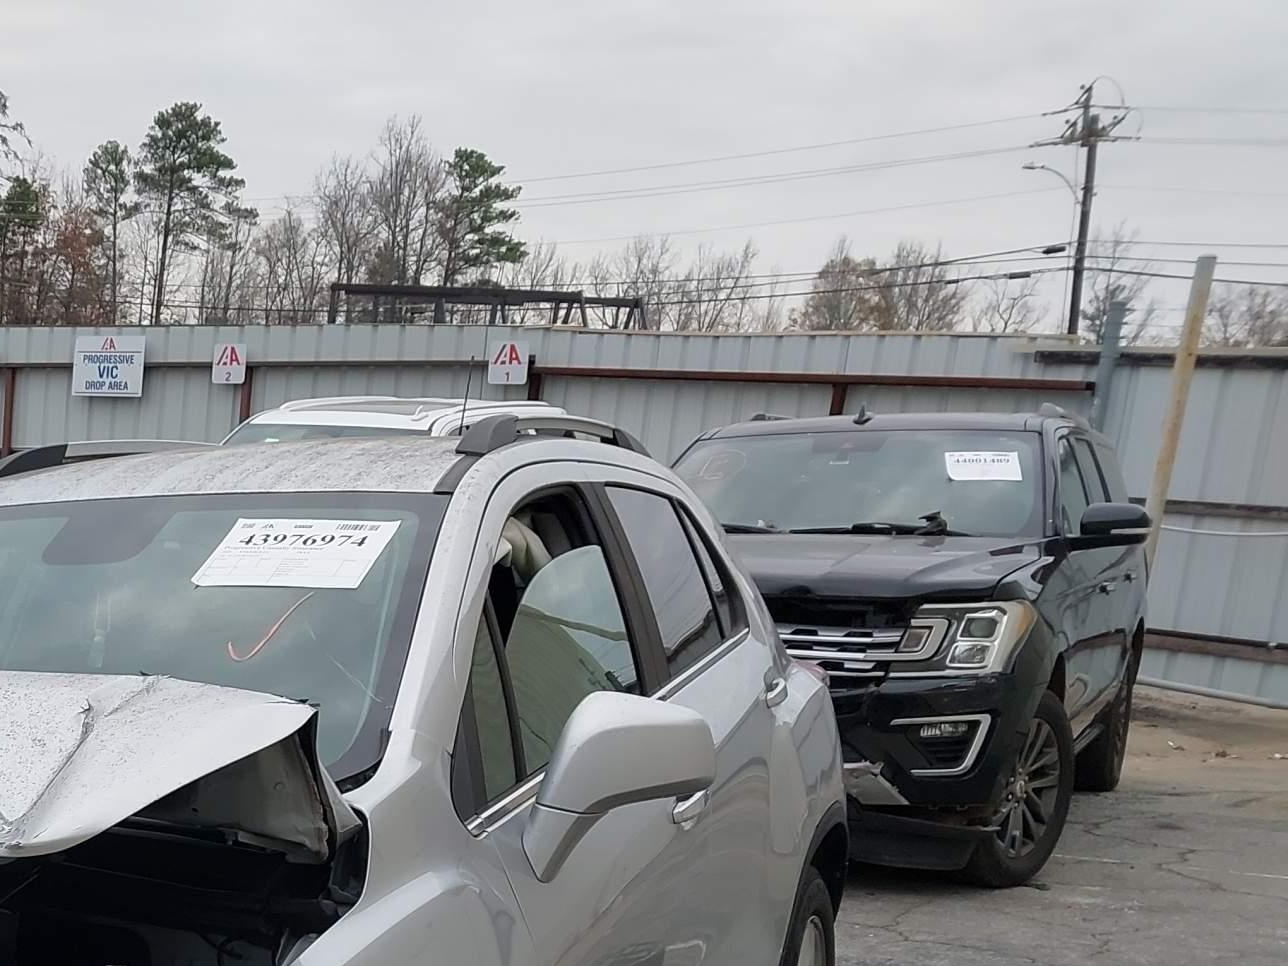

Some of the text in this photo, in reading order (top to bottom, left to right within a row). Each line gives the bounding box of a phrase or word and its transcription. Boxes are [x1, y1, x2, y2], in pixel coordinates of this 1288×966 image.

[83, 354, 135, 364] PROGRESSIVE
[98, 365, 118, 379] VIC
[225, 372, 232, 382] 2
[505, 372, 510, 382] 1
[85, 380, 129, 391] DROP AREA
[239, 533, 369, 548] 43976974
